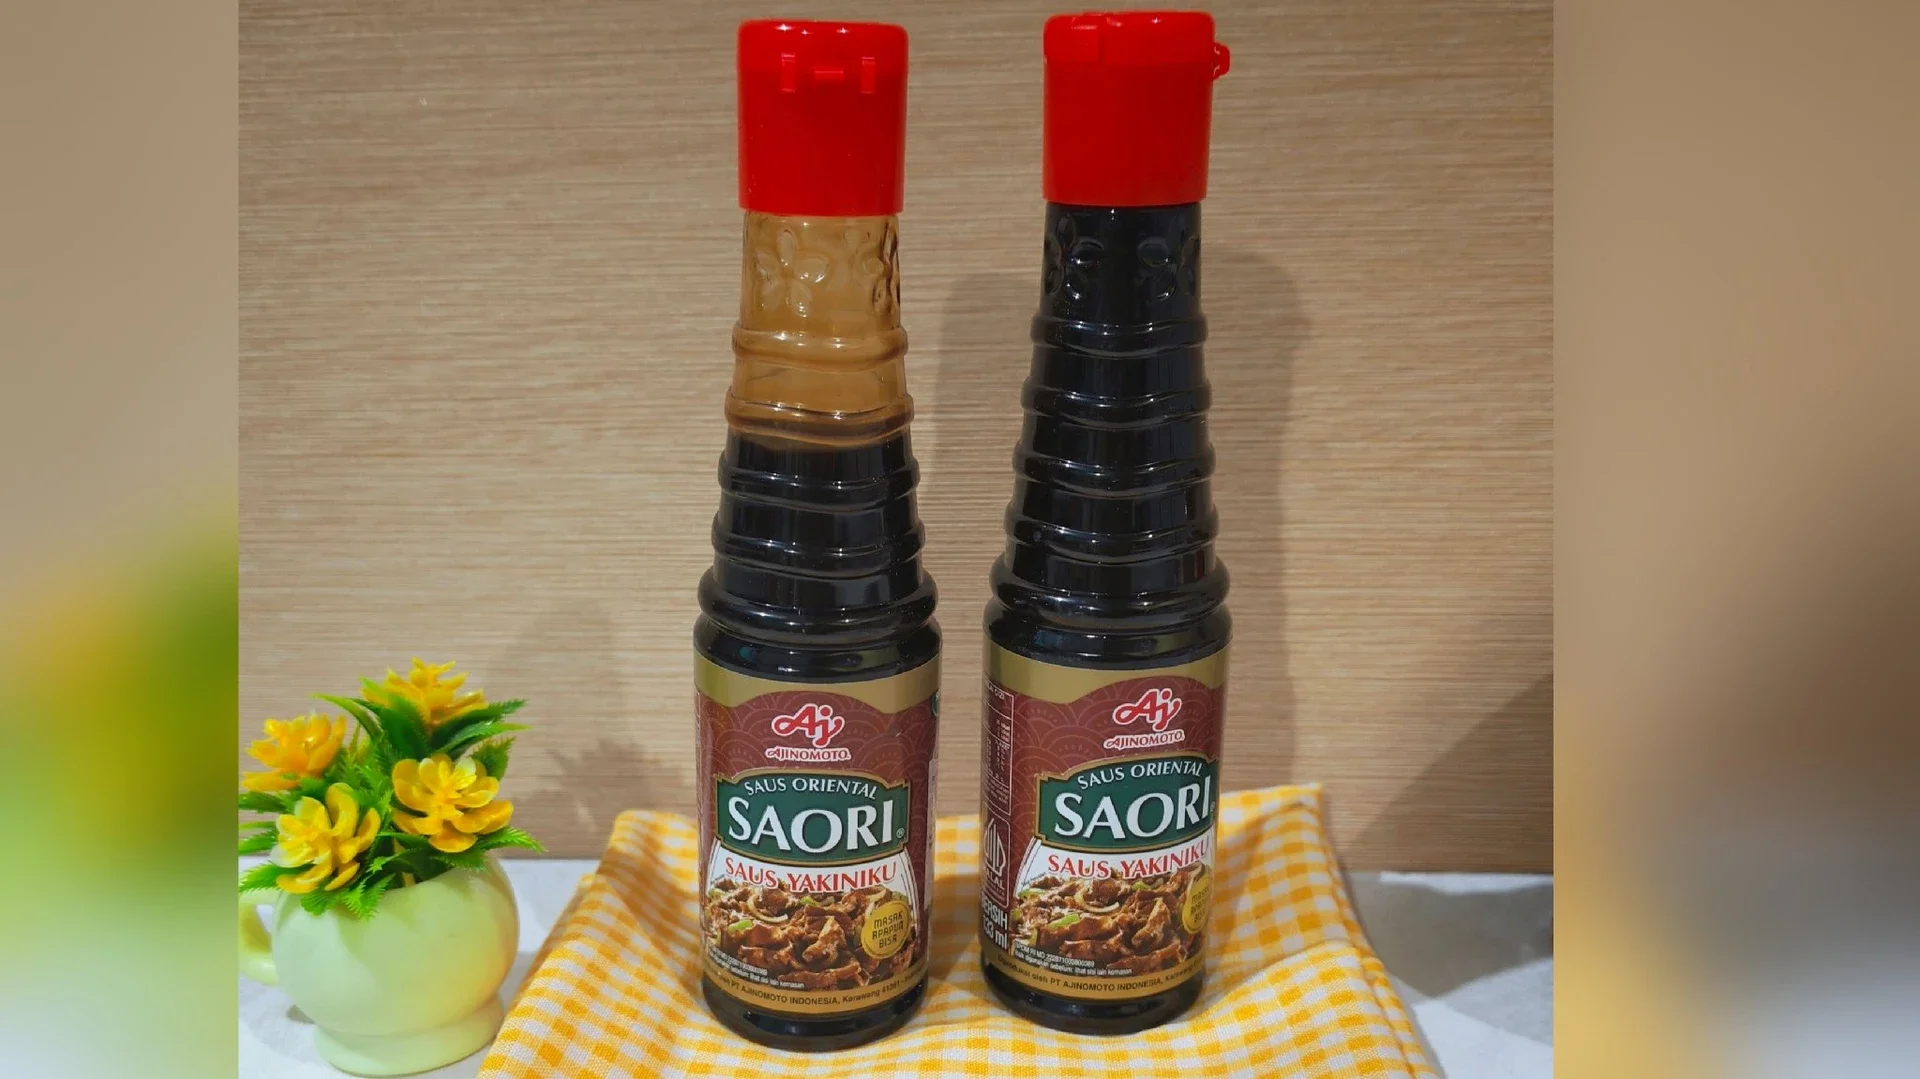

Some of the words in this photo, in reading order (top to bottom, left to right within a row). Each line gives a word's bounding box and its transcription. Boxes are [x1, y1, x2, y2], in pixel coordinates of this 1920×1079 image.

[1112, 688, 1182, 732] Aj
[772, 703, 845, 748] Aj
[1103, 728, 1186, 750] AJINOMOTO
[765, 746, 851, 762] AJINOMOTO
[1077, 767, 1125, 790] SAUS
[1130, 760, 1203, 778] ORIENTAL
[744, 777, 787, 796] SAUS
[792, 777, 878, 800] ORIENTAL
[1054, 775, 1211, 839] SAORI
[728, 796, 894, 853] SAORI
[1048, 854, 1110, 879] SAUS
[1120, 836, 1210, 878] YAKINIKU
[725, 856, 778, 888] SAUS
[787, 861, 898, 893] YAKINIKU
[873, 911, 903, 929] MASAK
[879, 934, 898, 948] BISA
[741, 987, 788, 1004] AJINOMOTO
[1050, 978, 1061, 987] PT
[1063, 981, 1115, 992] AJINOMOTO
